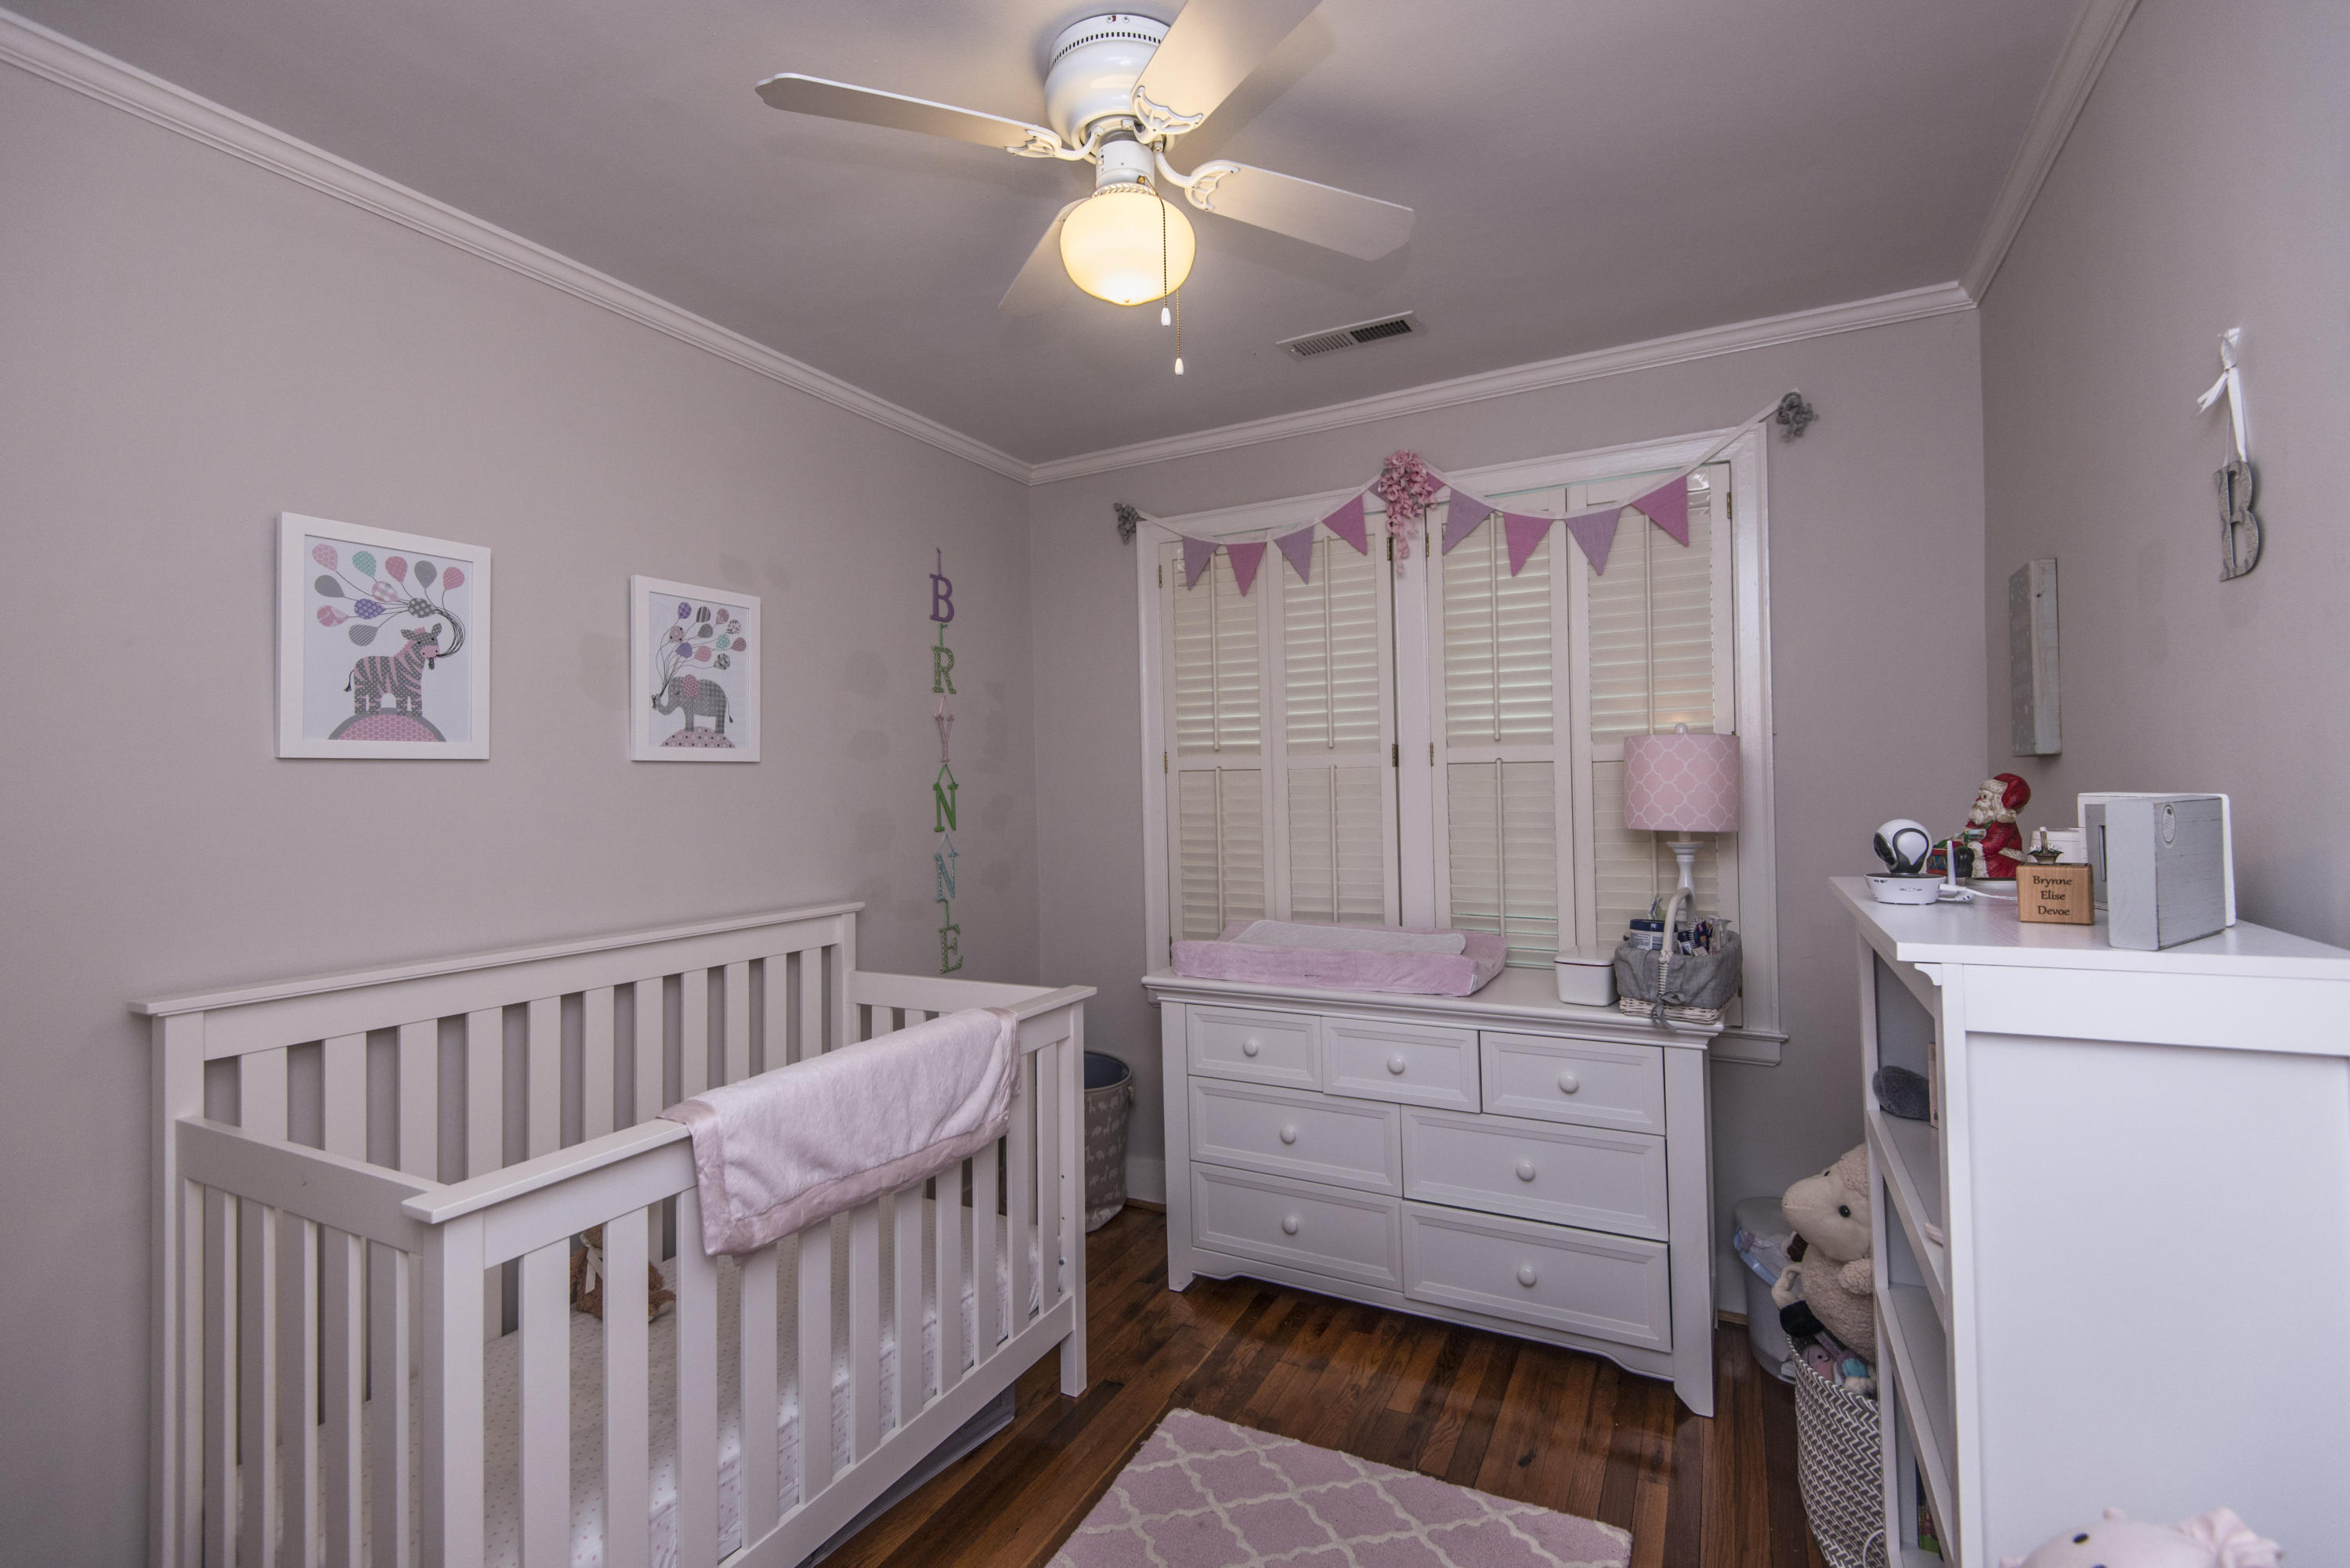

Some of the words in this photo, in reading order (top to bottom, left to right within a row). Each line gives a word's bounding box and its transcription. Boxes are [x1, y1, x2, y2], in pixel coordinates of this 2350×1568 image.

[2213, 460, 2259, 582] B
[929, 573, 964, 974] BRYNNE
[2033, 875, 2072, 887] Brynne
[2041, 890, 2066, 900] Elise
[2037, 905, 2070, 916] Devoe
